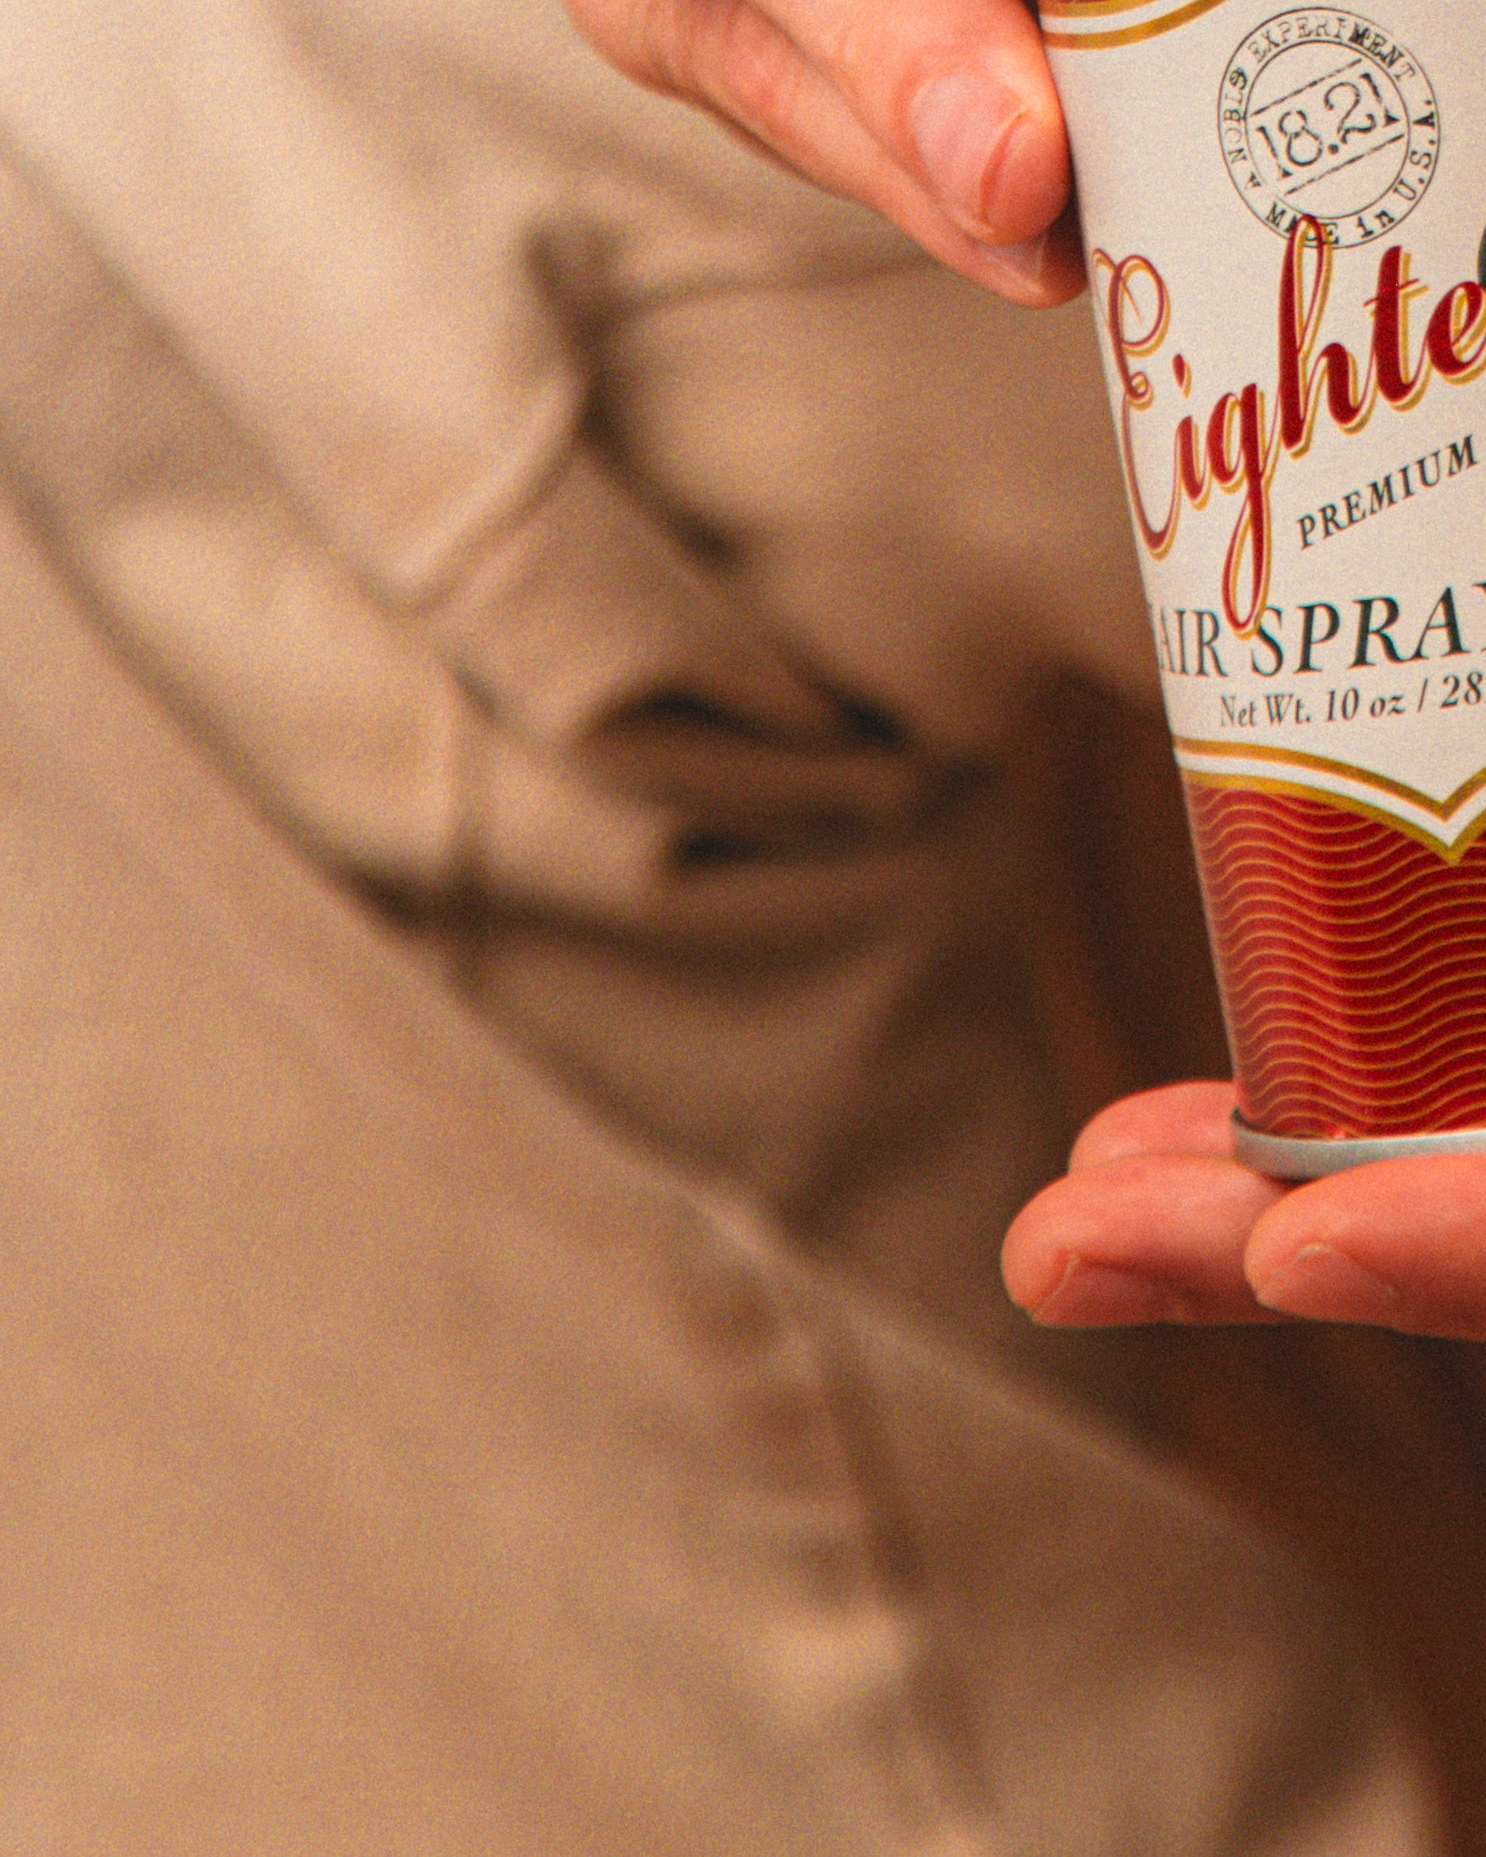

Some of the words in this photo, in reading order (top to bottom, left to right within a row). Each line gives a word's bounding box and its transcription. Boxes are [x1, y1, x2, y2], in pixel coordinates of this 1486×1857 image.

[1247, 16, 1416, 83] EXPERIMENT
[1256, 72, 1401, 180] 18.21
[1393, 98, 1437, 202] U.S.A.
[1296, 433, 1479, 551] PREMIUM
[1220, 694, 1257, 727] Net
[1264, 693, 1312, 725] Wt.
[1325, 686, 1360, 723] 10
[1369, 693, 1407, 718] oz
